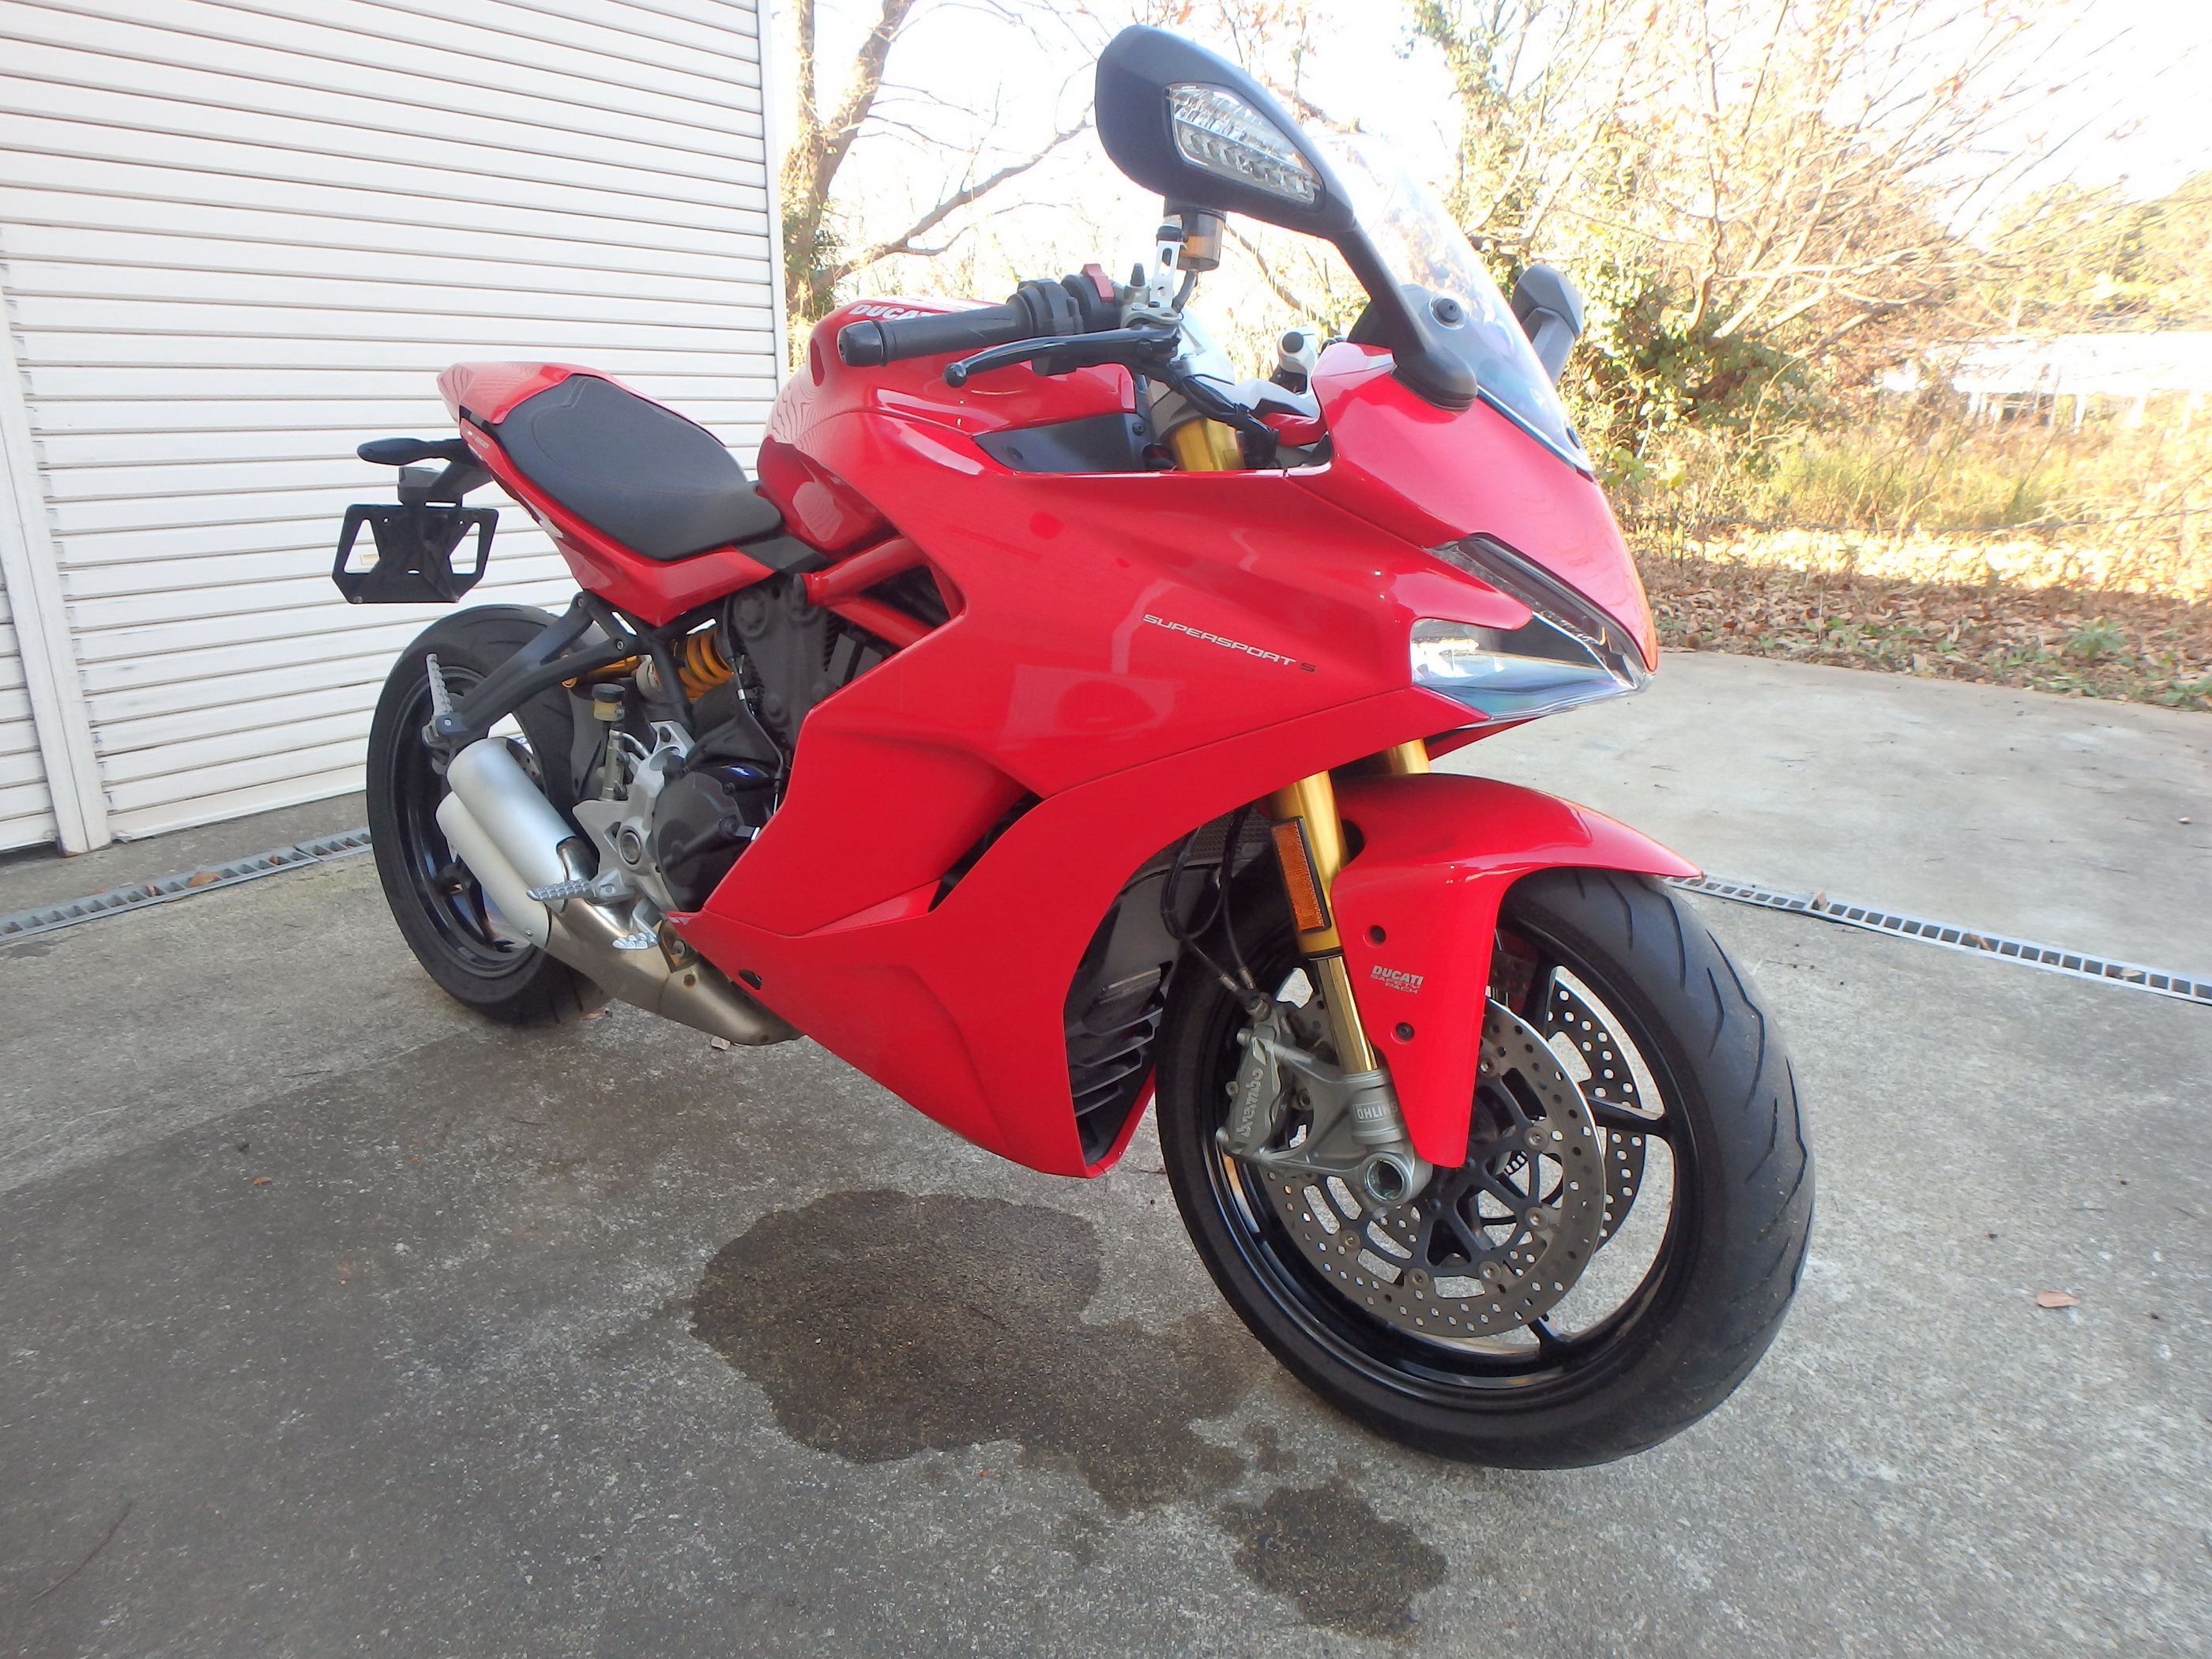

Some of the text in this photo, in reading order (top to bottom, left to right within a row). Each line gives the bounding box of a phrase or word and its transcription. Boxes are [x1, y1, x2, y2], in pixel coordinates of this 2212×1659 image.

[1142, 613, 1318, 672] SUPERSPORT S
[1371, 965, 1424, 986] DUCATI
[1236, 1067, 1264, 1138] brembo
